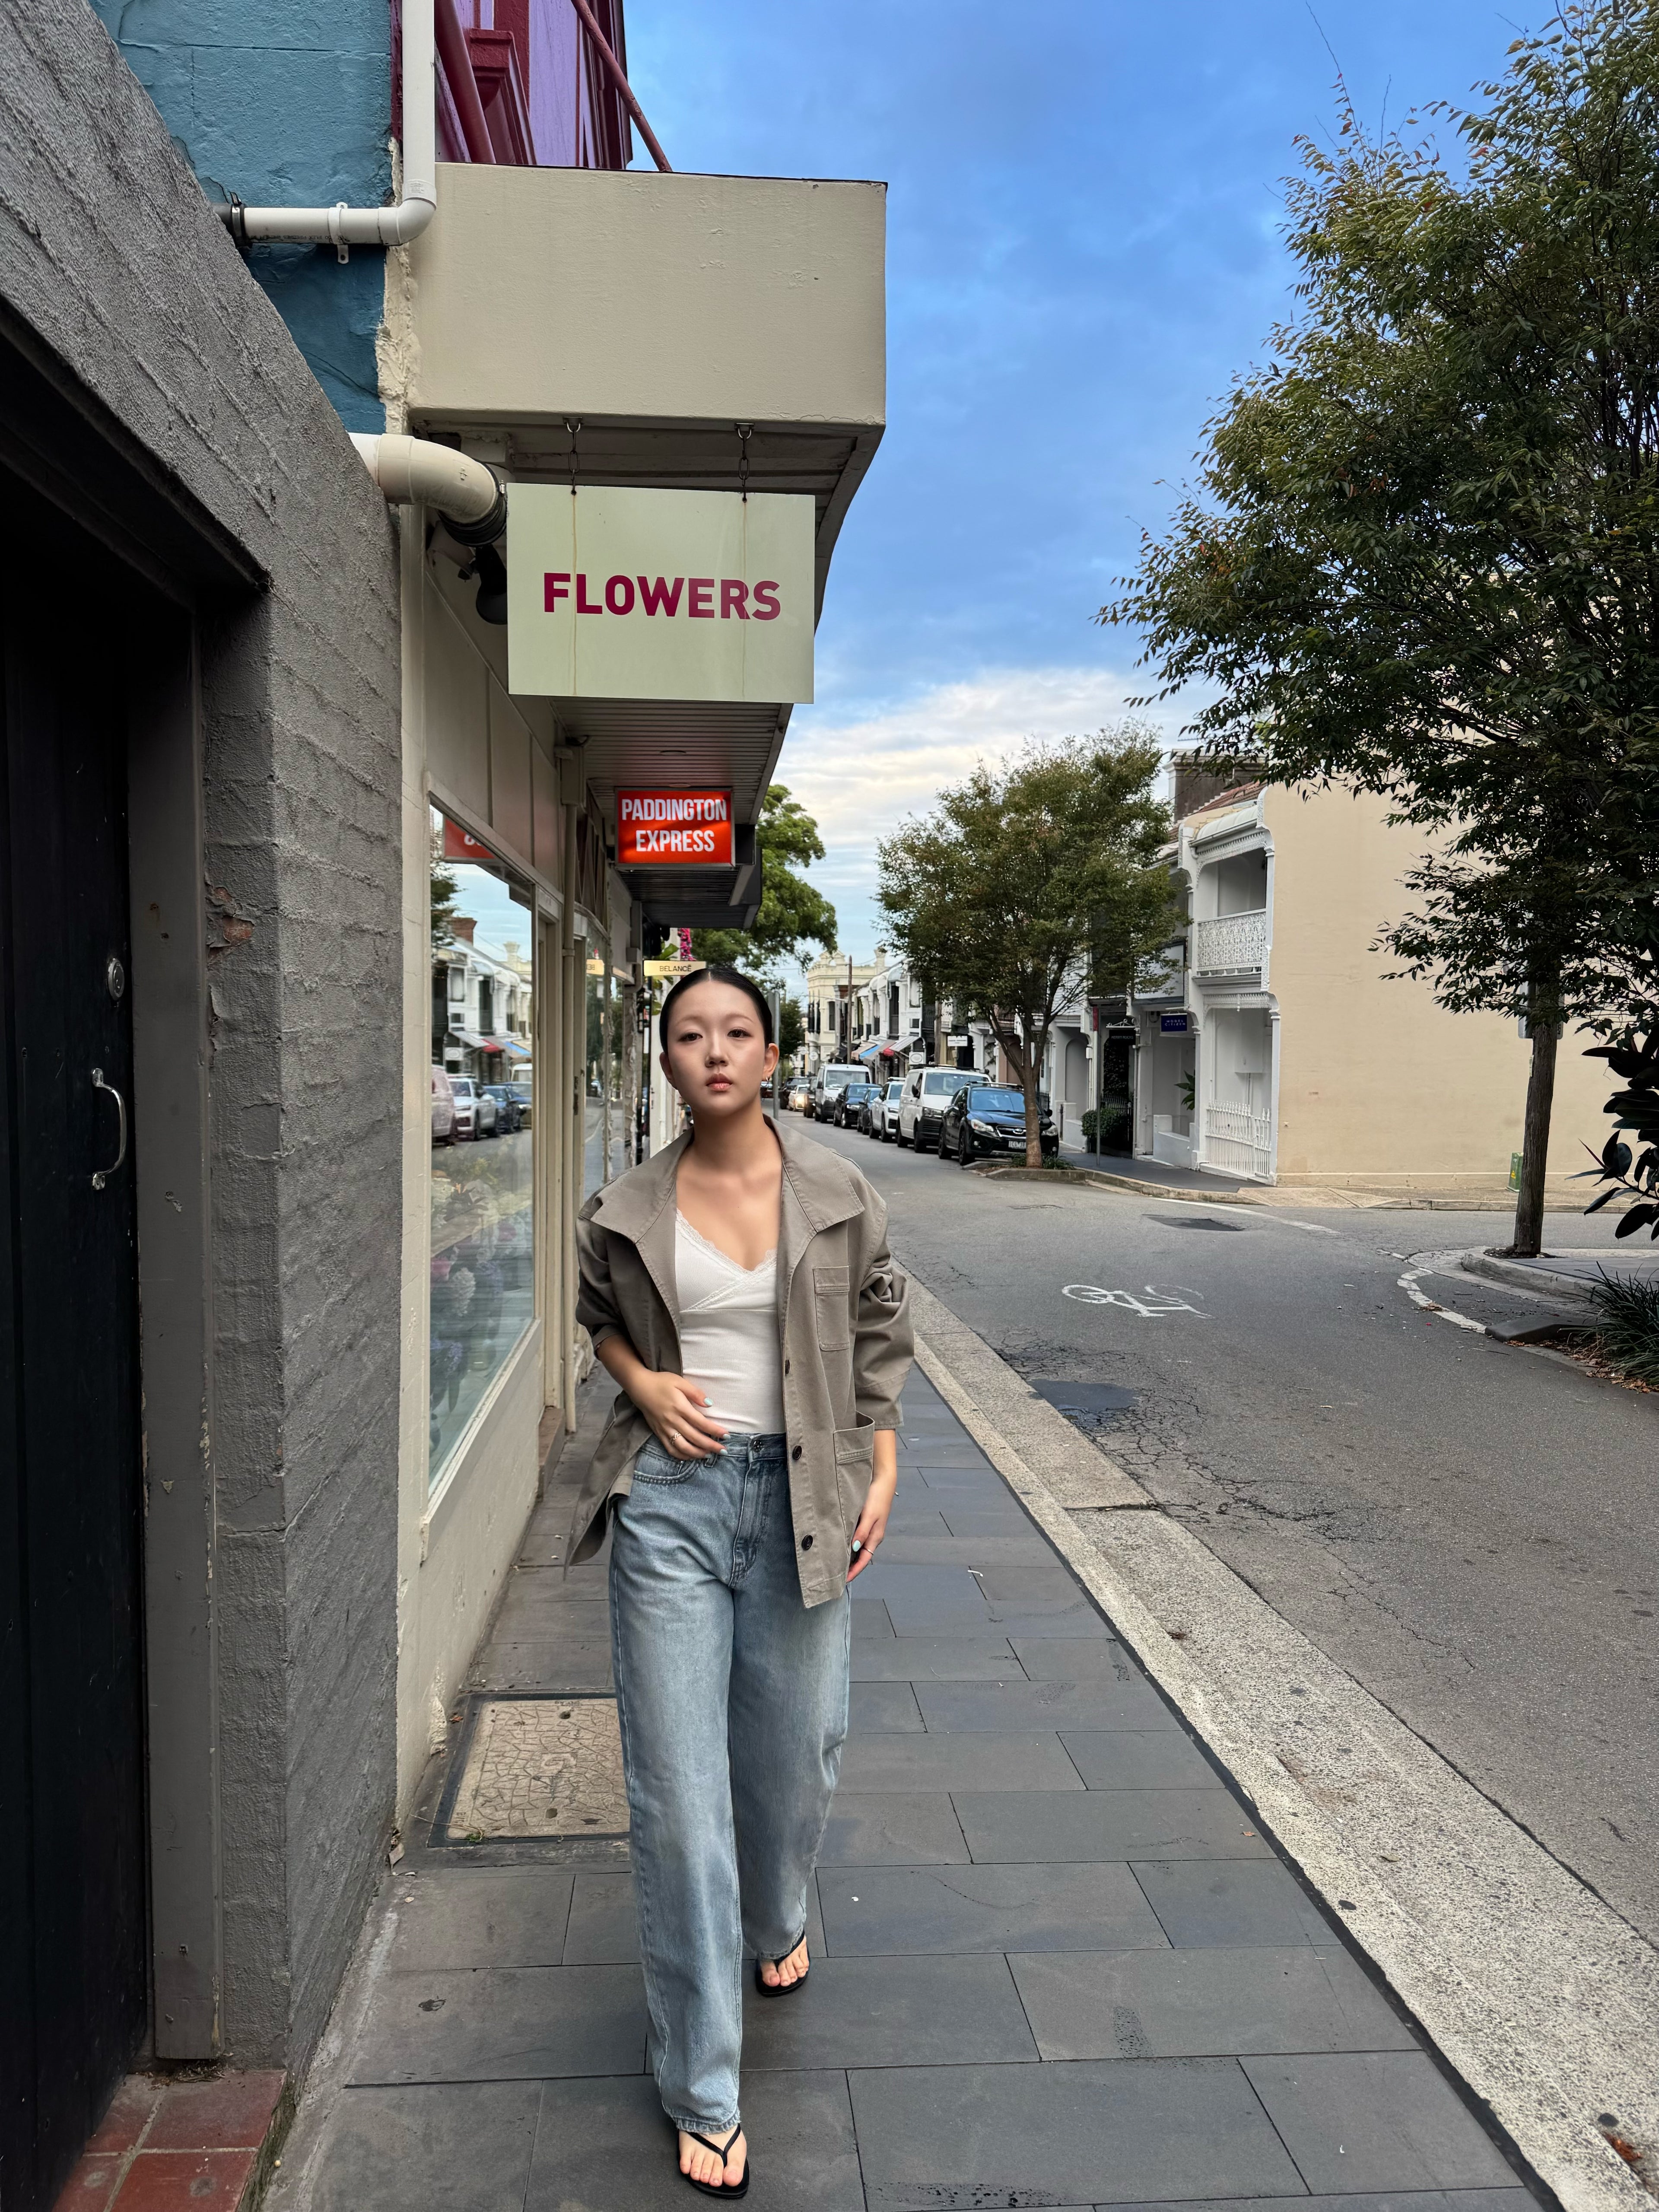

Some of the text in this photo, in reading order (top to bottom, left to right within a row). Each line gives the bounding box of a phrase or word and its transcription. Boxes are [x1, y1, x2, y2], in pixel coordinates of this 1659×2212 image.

[544, 573, 781, 621] FLOWERS
[622, 799, 727, 820] PADDINGTON
[636, 830, 715, 852] EXPRESS
